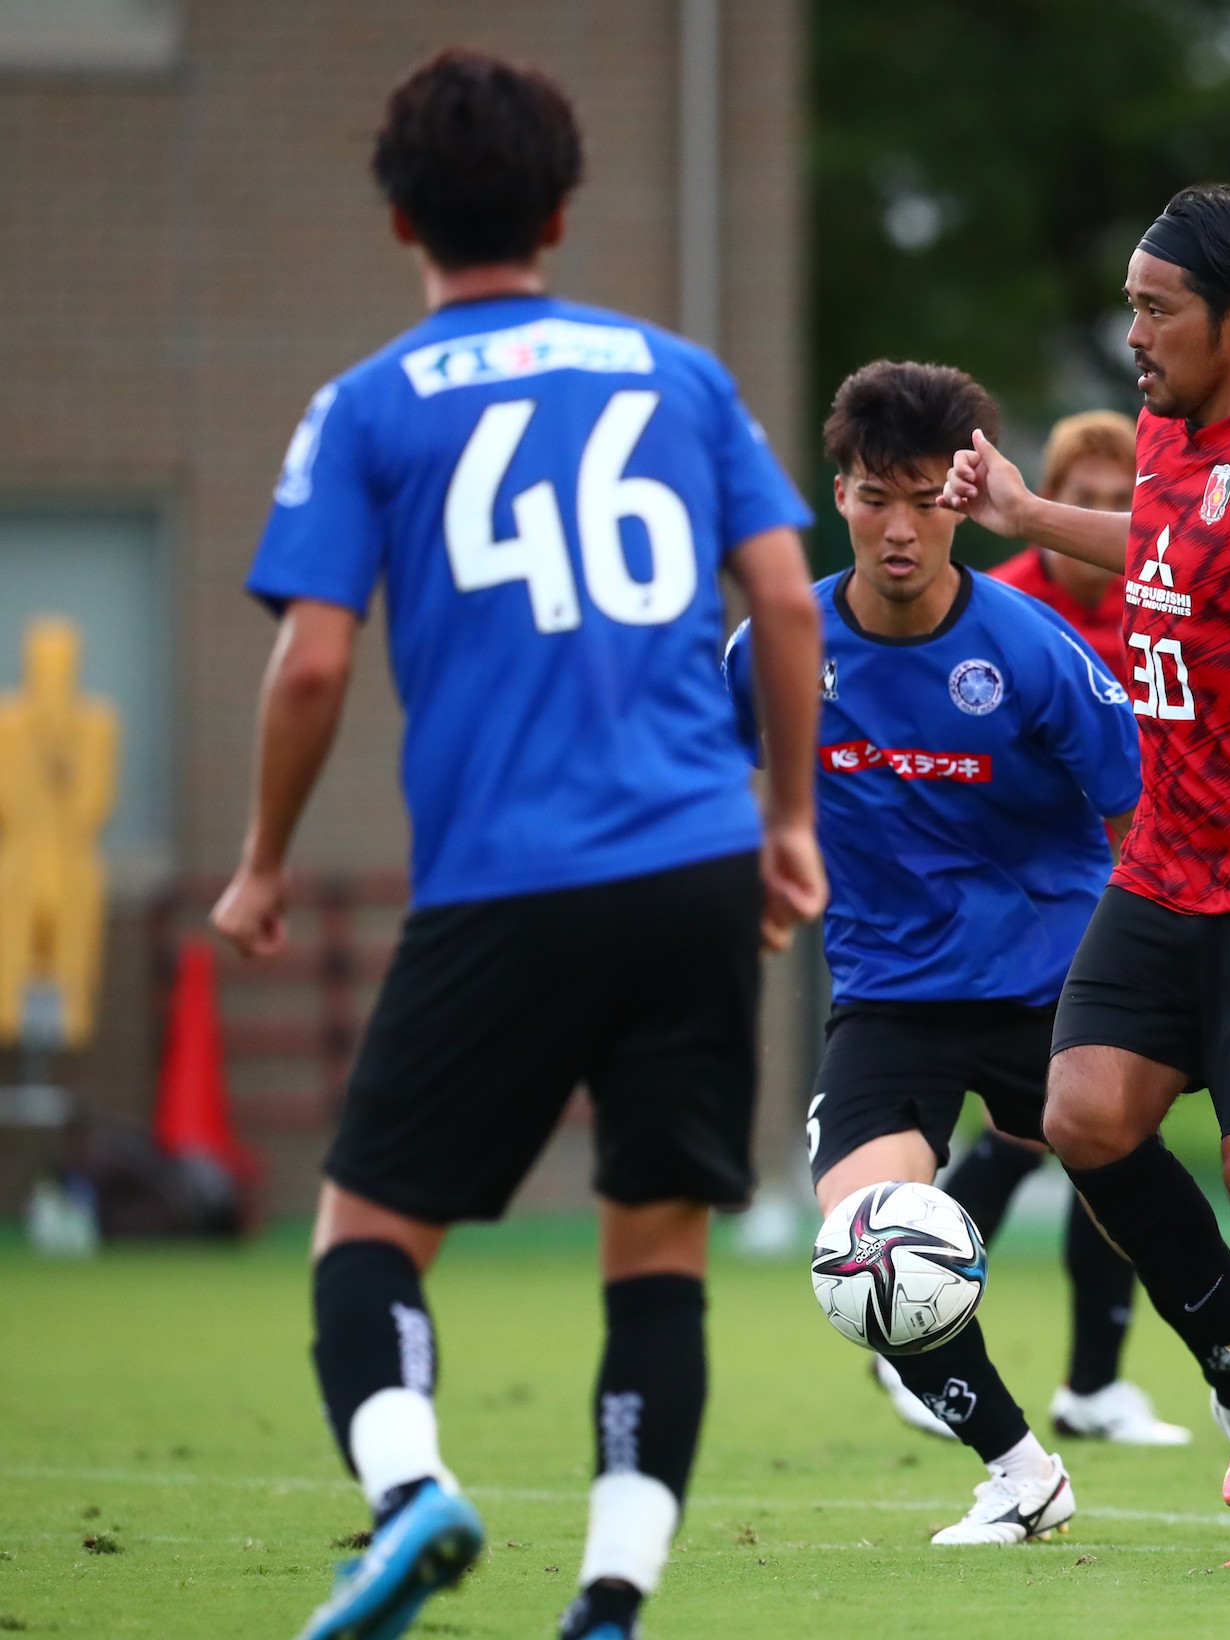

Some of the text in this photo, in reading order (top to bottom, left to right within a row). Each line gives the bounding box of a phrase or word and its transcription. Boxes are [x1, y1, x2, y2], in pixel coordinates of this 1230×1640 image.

[443, 388, 698, 634] 46
[1126, 580, 1191, 608] MITSUBISHI
[1142, 599, 1191, 617] INDUSTRIES
[1128, 632, 1196, 720] 30
[855, 1239, 888, 1264] adidas
